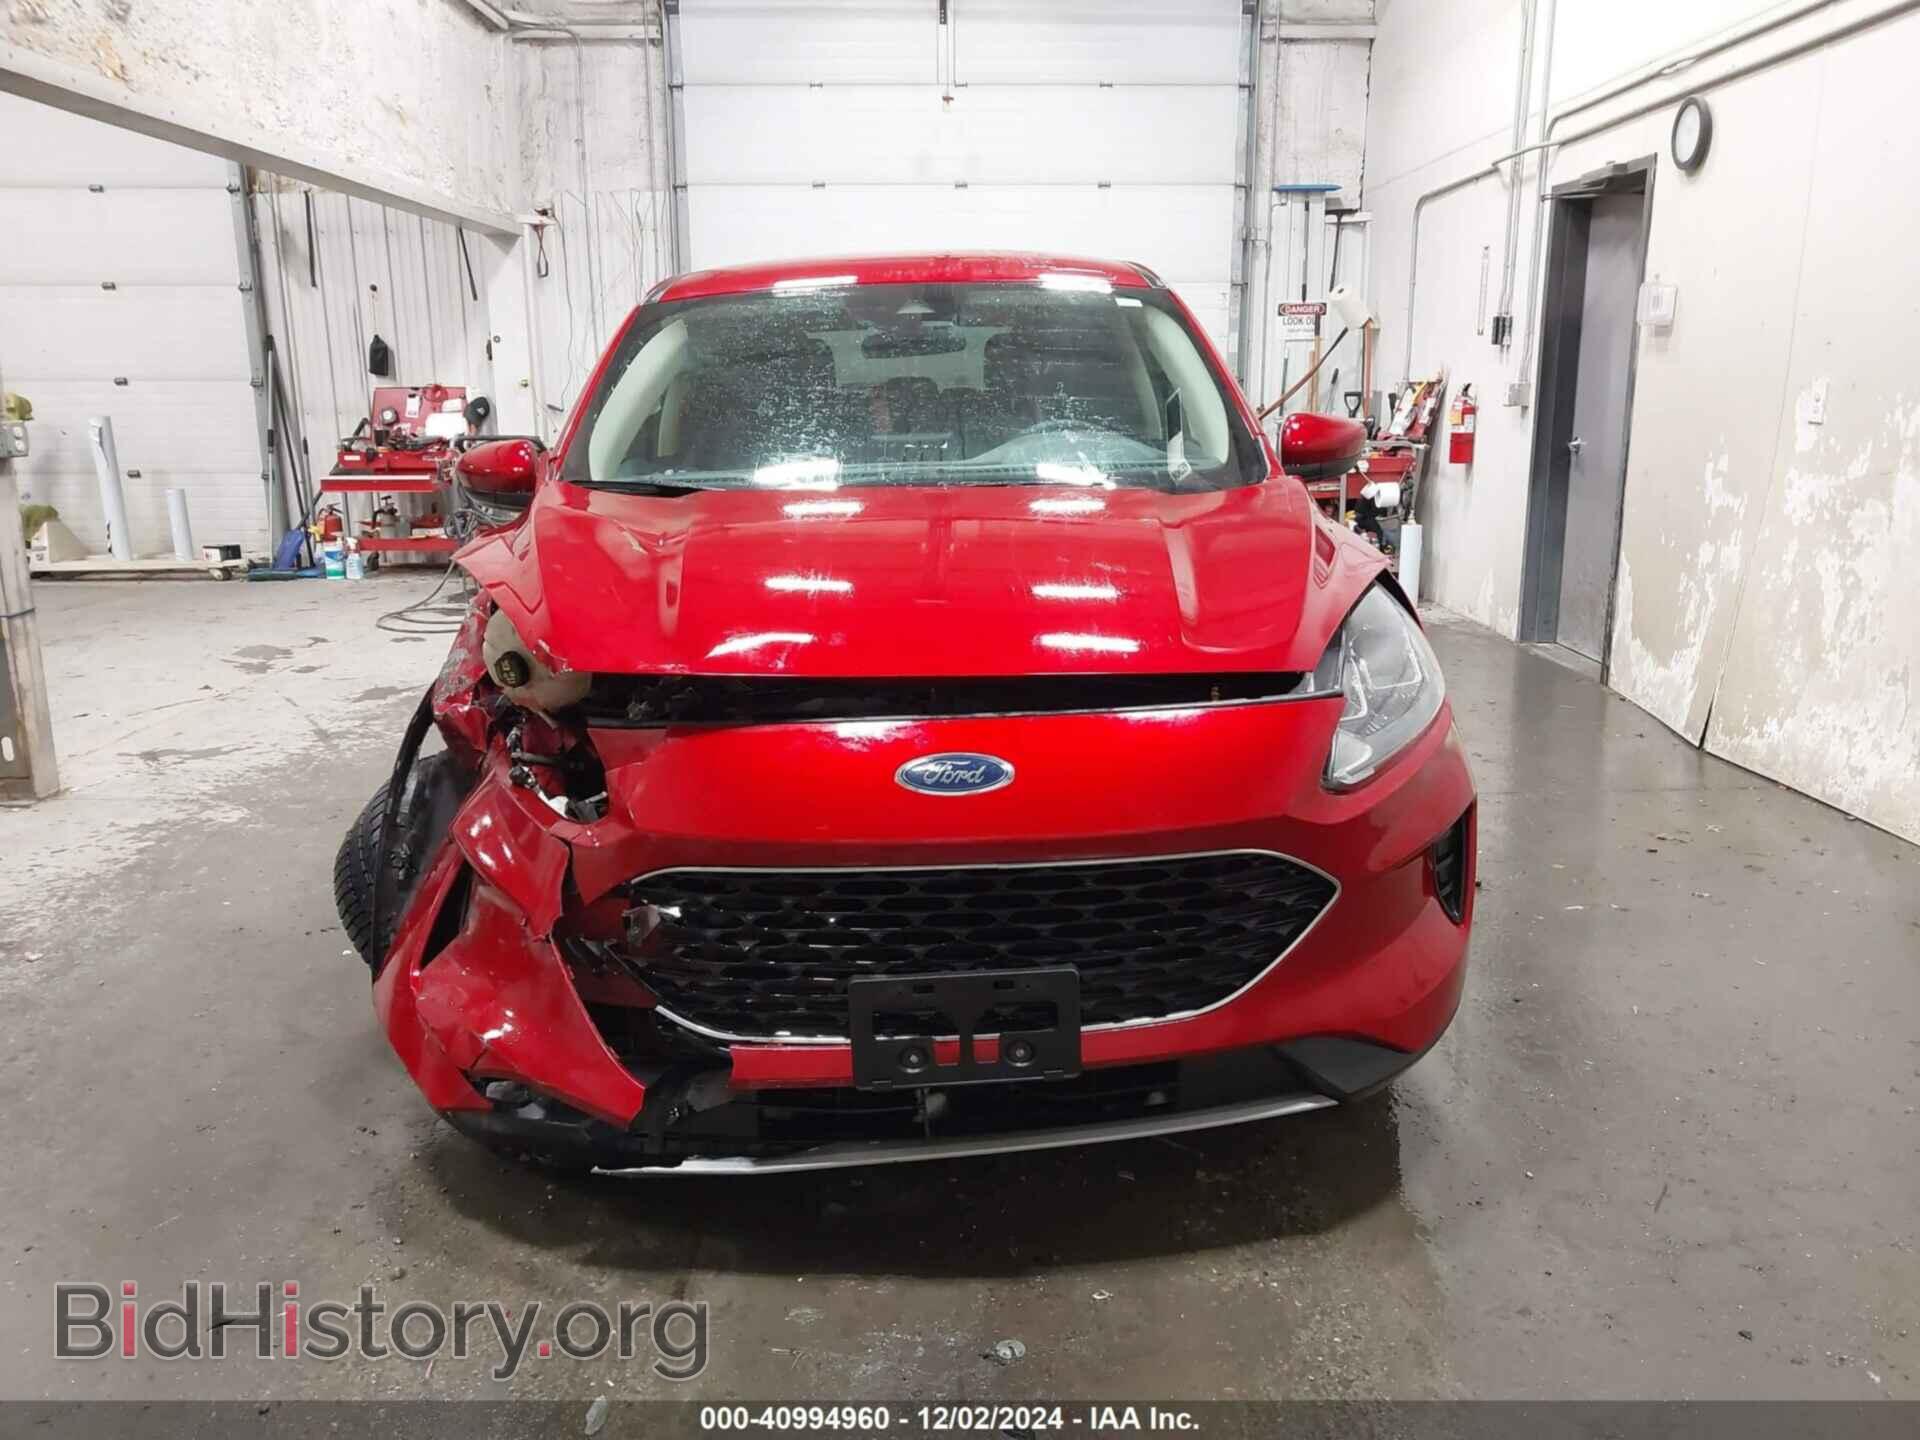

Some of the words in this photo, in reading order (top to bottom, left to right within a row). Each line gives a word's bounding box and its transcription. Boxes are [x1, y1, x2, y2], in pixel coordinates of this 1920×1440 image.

[1285, 304, 1321, 313] DANGER
[1282, 317, 1304, 326] LOOK
[922, 760, 986, 785] Ford
